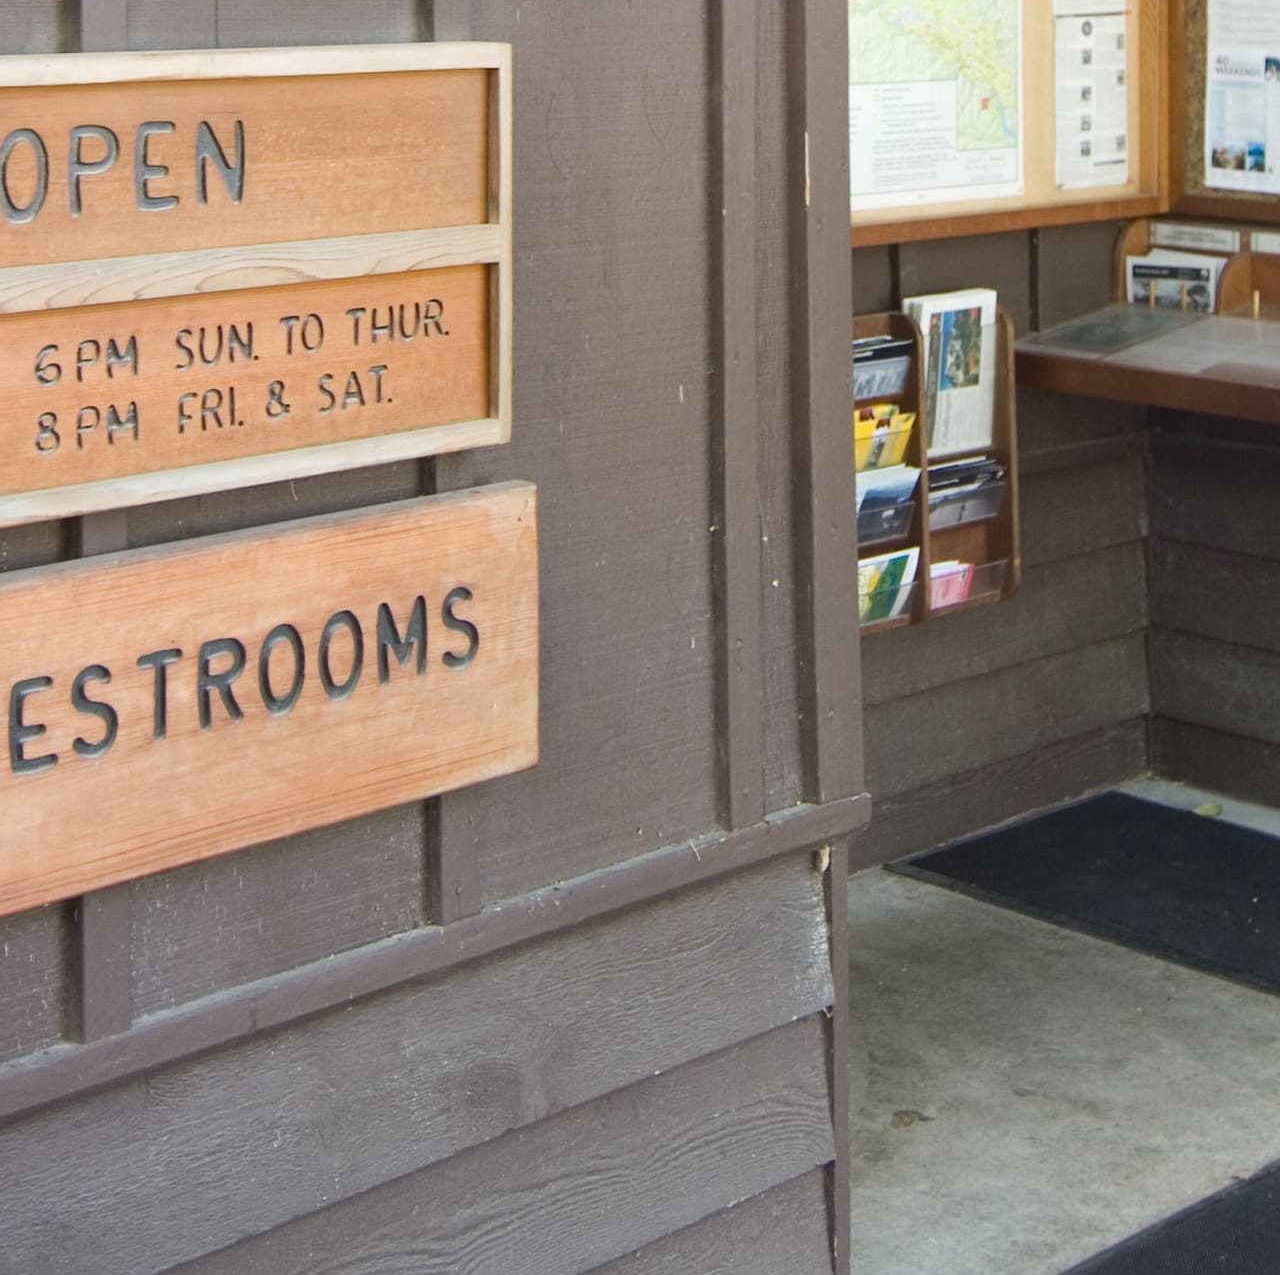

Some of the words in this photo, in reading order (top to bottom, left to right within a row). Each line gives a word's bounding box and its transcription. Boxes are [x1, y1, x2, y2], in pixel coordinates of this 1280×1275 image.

[175, 322, 260, 373] SUN.
[280, 312, 325, 355] TO
[346, 298, 450, 347] THUR.
[177, 386, 245, 434] FRI.
[265, 380, 291, 419] &
[318, 364, 394, 413] SAT.
